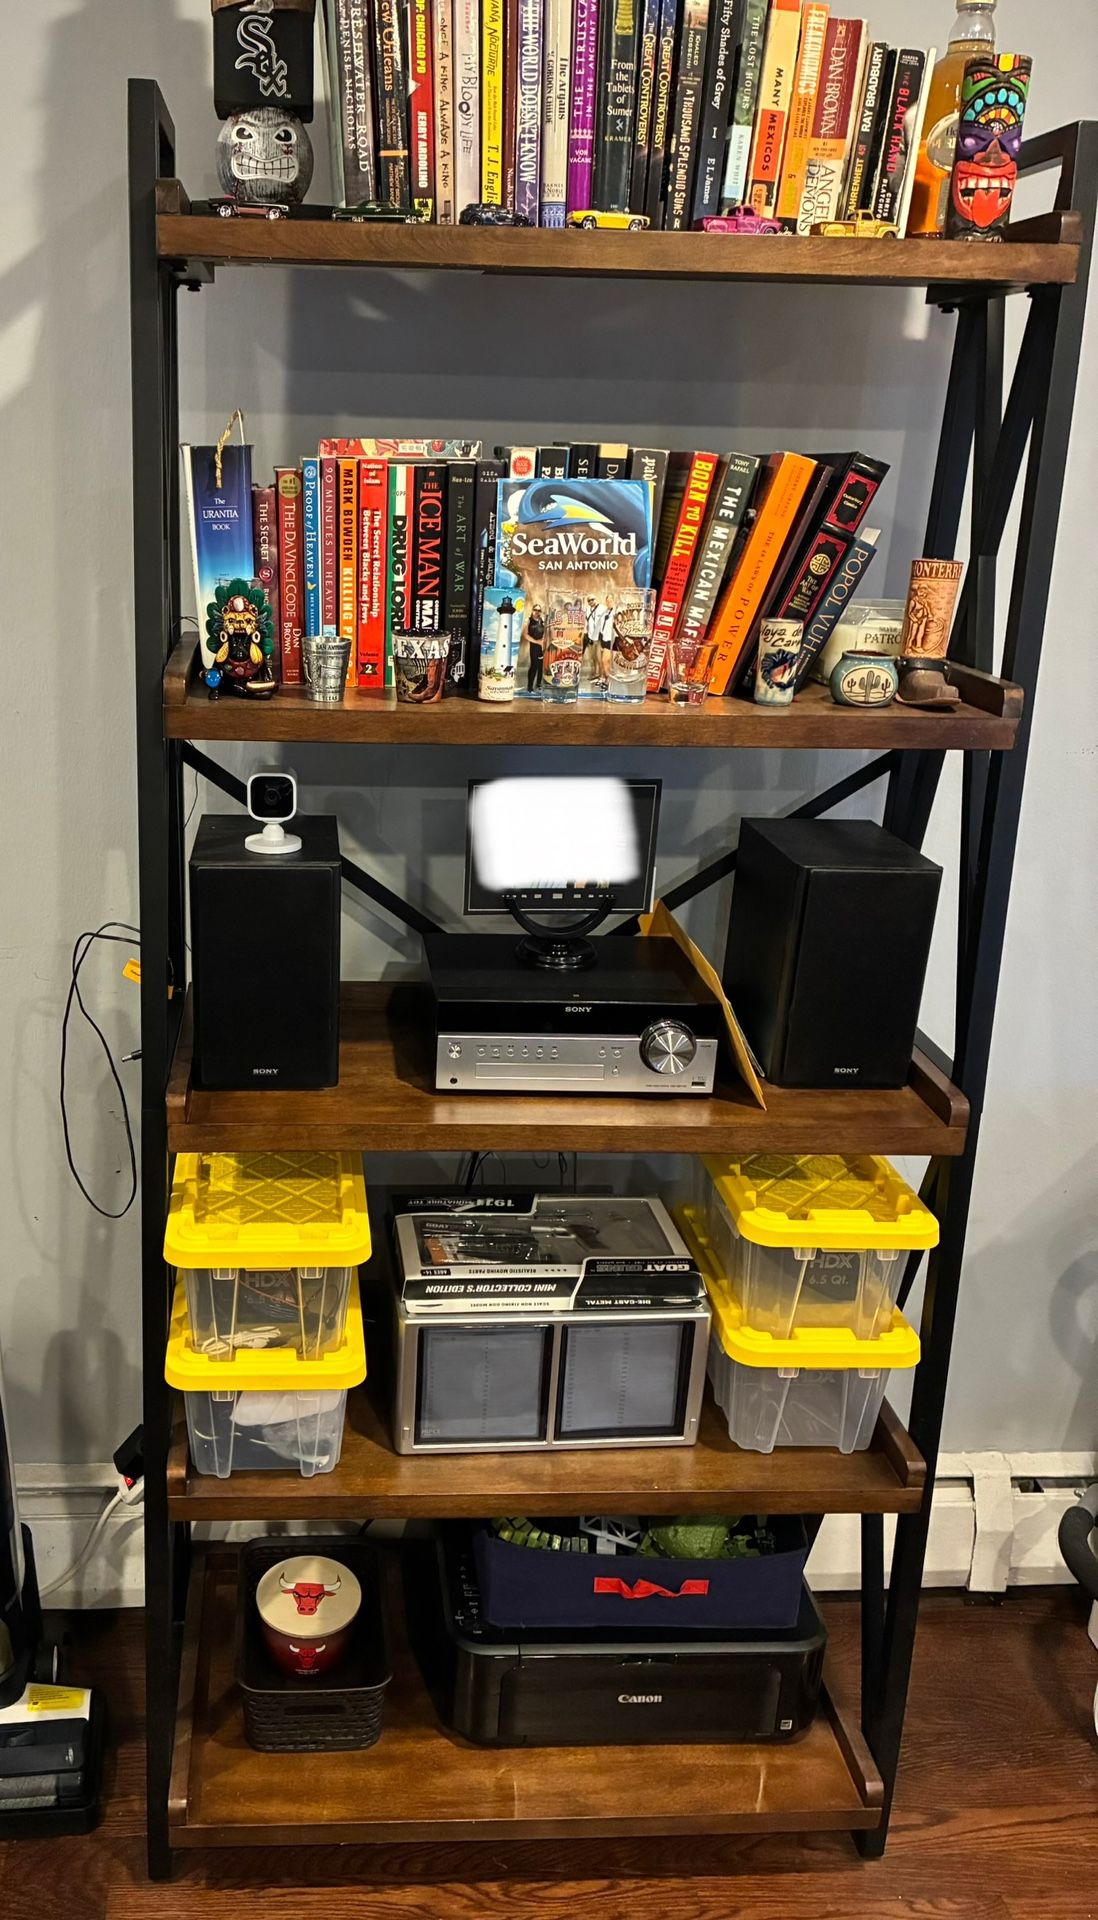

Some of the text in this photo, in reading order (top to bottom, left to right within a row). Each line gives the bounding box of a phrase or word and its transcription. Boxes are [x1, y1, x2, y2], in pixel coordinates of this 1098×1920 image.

[383, 28, 395, 91] Orleans
[416, 14, 427, 74] CHICAGO PD
[440, 52, 450, 61] A
[485, 23, 500, 77] NOCTURNE
[521, 32, 540, 81] WORLD
[642, 33, 657, 68] GREAT
[661, 37, 674, 71] GREAT
[686, 30, 696, 69] HOSSEINI
[693, 34, 702, 66] KHALED
[711, 0, 734, 110] Fifty Shades of Grey
[798, 10, 827, 95] FREAKONOMICS
[546, 60, 555, 93] GORDON
[585, 20, 596, 117] IN THE ANCIENT
[611, 58, 634, 70] From
[615, 71, 629, 81] the
[742, 17, 761, 109] THE LOST HOURS
[828, 47, 847, 80] DAN
[341, 20, 357, 150] DENISE NICHOLAS
[458, 76, 478, 129] BLOODY
[557, 57, 569, 120] The Aryans
[573, 86, 584, 117] THE
[606, 82, 635, 94] Tablets
[616, 94, 626, 104] of
[772, 68, 784, 107] MANY
[861, 46, 884, 132] RAY BRADBURY
[440, 99, 451, 145] ALWAYS
[607, 105, 633, 117] Sumer
[637, 68, 654, 148] CONTROVERSY
[654, 72, 671, 149] CONTROVERSY
[679, 96, 696, 143] THOUSAND
[820, 83, 842, 135] BROWN
[357, 125, 369, 172] ROAD
[460, 130, 473, 154] LIFE
[762, 113, 777, 171] MEXICOS
[886, 88, 910, 173] BLACK HAND
[417, 111, 428, 188] JERRY ARDOLINO
[440, 150, 451, 159] A
[519, 143, 537, 184] KNOW
[676, 145, 691, 190] SPLENDID
[442, 163, 451, 189] KING
[703, 175, 714, 205] James
[848, 158, 865, 214] AHRENHEIT
[673, 192, 686, 216] SUNS
[799, 163, 821, 232] DEMONS
[883, 192, 892, 217] CHRIS
[730, 464, 750, 474] RAFAEL
[734, 458, 750, 466] TONY
[687, 459, 714, 503] BORN
[202, 509, 239, 519] URANTIA
[284, 502, 296, 528] THE
[304, 481, 316, 519] PROOF
[685, 506, 701, 521] TO
[212, 523, 231, 531] BOOK
[259, 501, 270, 562] THE SECRET
[284, 531, 297, 549] DA
[325, 467, 334, 619] 90 MINUTES IN HEAVEN
[342, 469, 354, 620] MARK BOWDEN KILLING
[418, 491, 442, 597] ICE MAN
[454, 496, 467, 592] The ART WAR
[511, 532, 638, 556] SeaWorld
[671, 524, 699, 557] KILL
[694, 487, 742, 601] THE MEXICAN
[305, 531, 317, 578] HEAVEN
[391, 515, 408, 577] DRUG
[285, 549, 297, 582] VINCI
[361, 510, 371, 625] Between Blacks and Jews
[370, 510, 382, 619] The Secret Relationship
[538, 560, 619, 570] SAN ANTONIO
[806, 575, 818, 585] THE
[913, 562, 964, 579] ONTERR
[285, 584, 297, 618] CODE
[802, 547, 869, 652] POPOL VUH
[283, 622, 293, 654] BROWN
[291, 628, 302, 649] DAN
[717, 597, 750, 662] POWER
[761, 624, 787, 643] laya
[365, 664, 373, 674] 2
[647, 629, 671, 680] ENGLISH
[644, 1264, 690, 1272] GOAT
[810, 1253, 855, 1269] HDX
[245, 1272, 291, 1288] HDX
[425, 1283, 557, 1293] MINI COLLECTOR'S EDITION
[808, 1275, 827, 1285] 6.5
[617, 1693, 663, 1704] Canon
